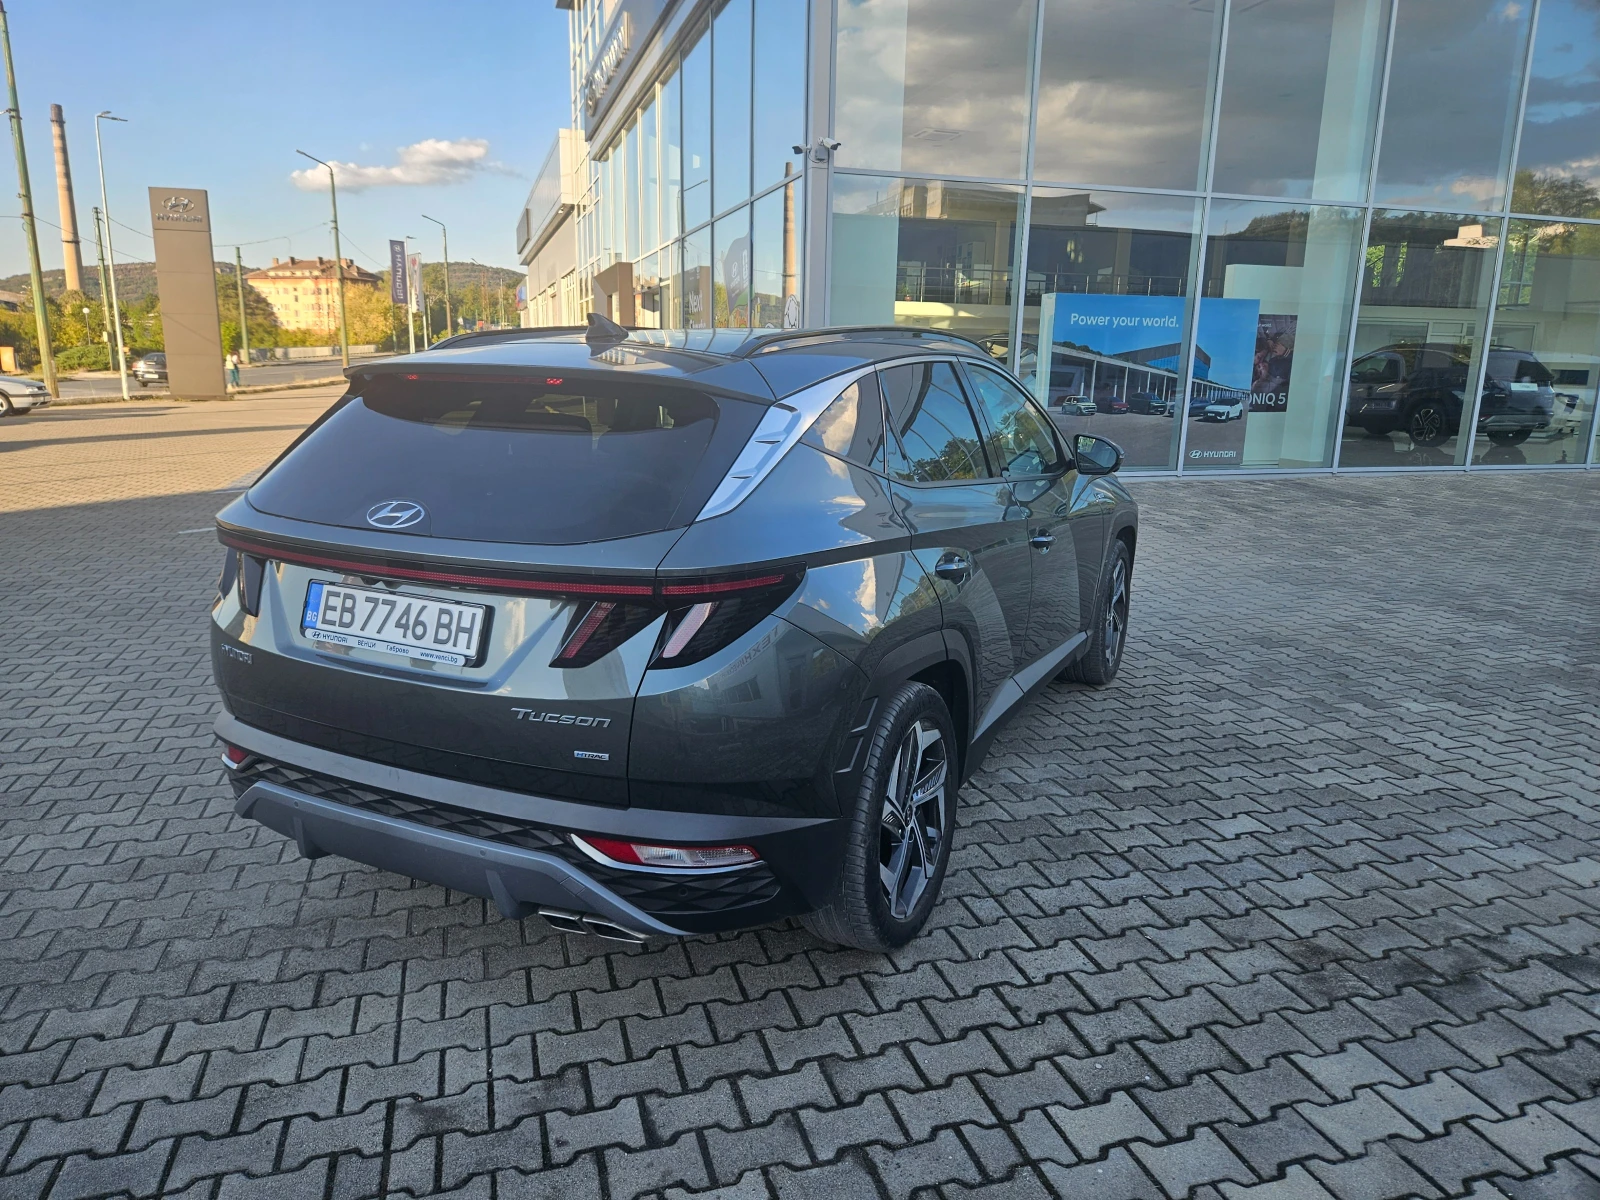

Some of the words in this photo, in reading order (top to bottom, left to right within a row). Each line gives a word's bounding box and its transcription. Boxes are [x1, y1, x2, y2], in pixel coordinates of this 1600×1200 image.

[1070, 313, 1110, 326] Power
[1112, 316, 1140, 329] your
[1142, 315, 1179, 328] world.
[1277, 392, 1286, 405] 5
[1203, 450, 1237, 458] HYUNDAI
[306, 611, 318, 622] BG
[321, 590, 357, 628] EB
[360, 596, 428, 641] 7746
[433, 607, 477, 650] BH
[322, 633, 349, 644] HYUNDAI
[420, 651, 459, 665] www.venci.bg
[576, 752, 607, 760] HTRAC
